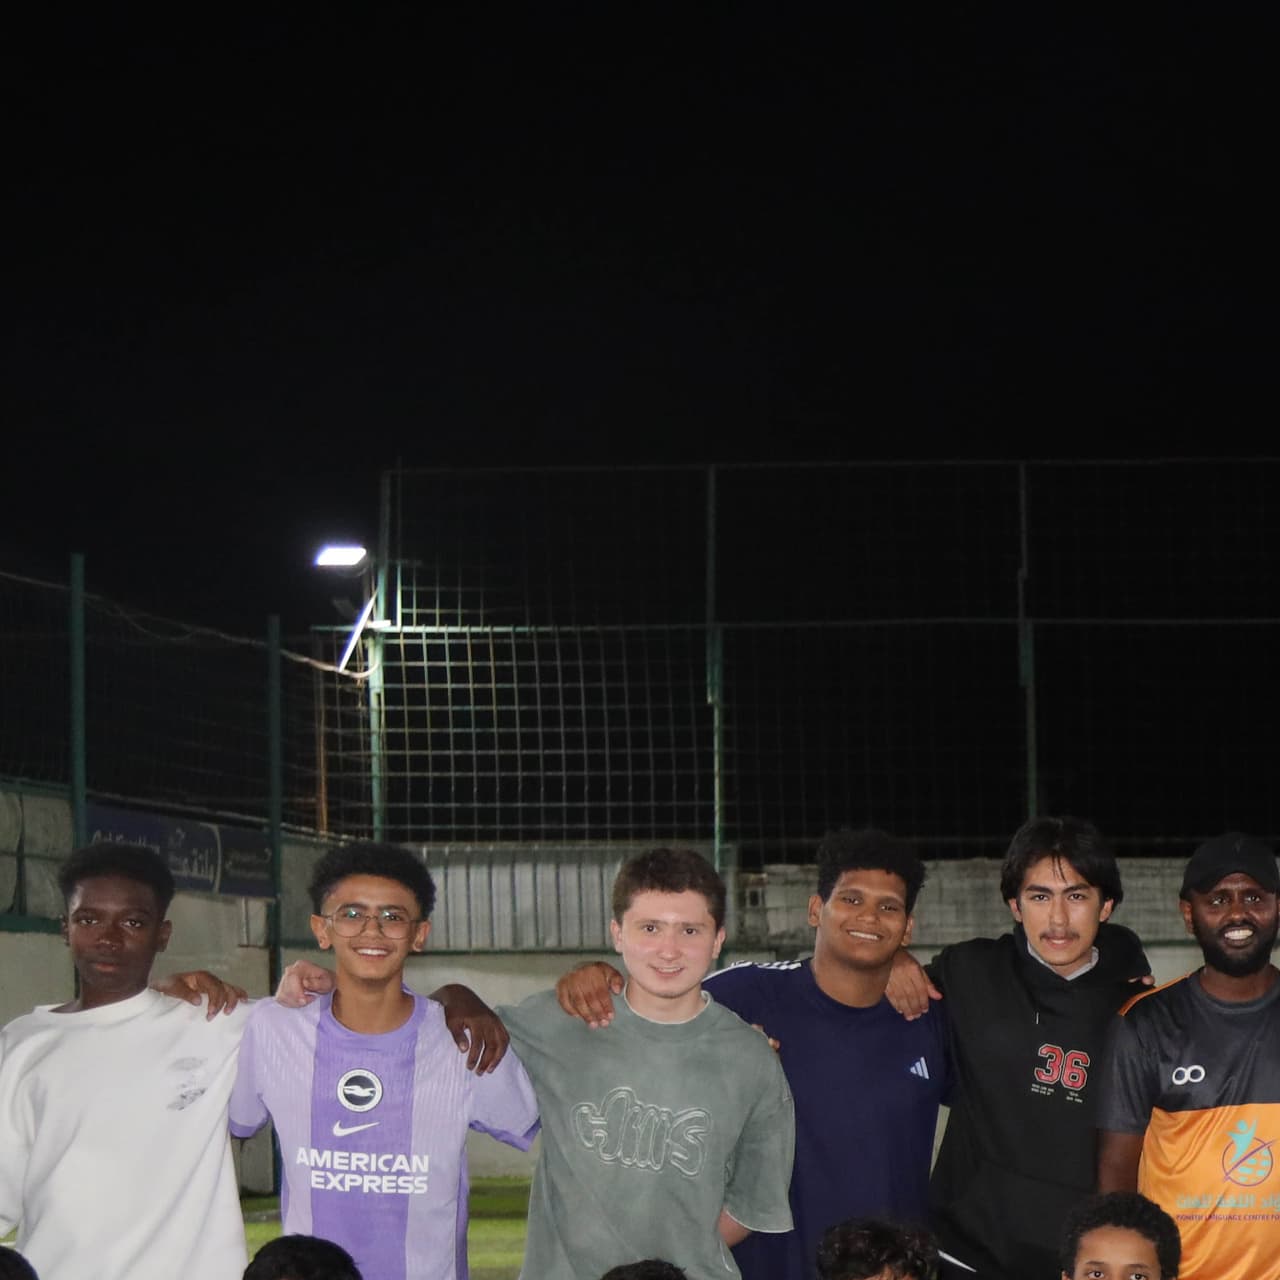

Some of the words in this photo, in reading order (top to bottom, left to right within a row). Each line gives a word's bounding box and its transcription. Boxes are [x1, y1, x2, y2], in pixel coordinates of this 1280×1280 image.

[1034, 1043, 1090, 1091] 36
[296, 1147, 429, 1173] AMERICAN
[311, 1170, 429, 1194] EXPRESS
